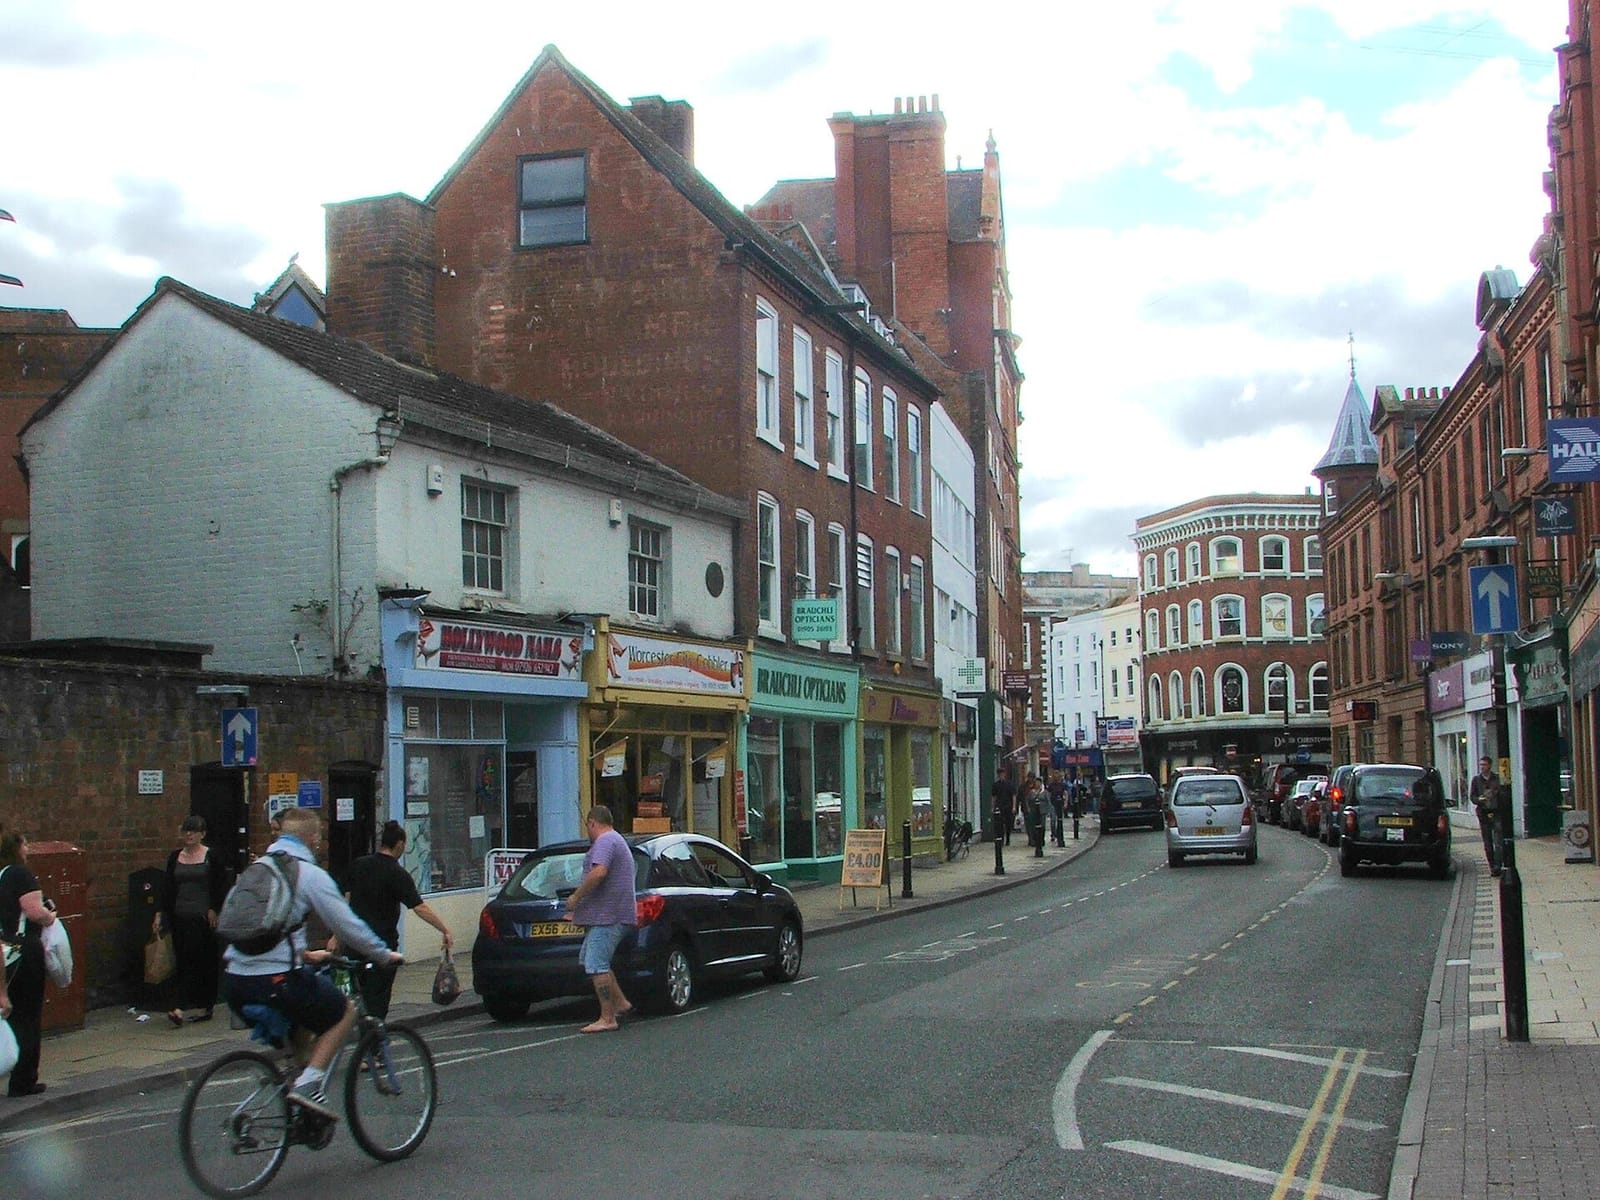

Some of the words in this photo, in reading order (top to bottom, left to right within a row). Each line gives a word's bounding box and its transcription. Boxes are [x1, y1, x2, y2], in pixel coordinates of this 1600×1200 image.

[1552, 441, 1600, 458] HAL
[795, 615, 836, 624] OPTICIANS
[440, 625, 524, 658] HOLLYWOOD
[525, 635, 563, 661] NAILS
[628, 645, 673, 663] Worcester
[697, 654, 728, 672] Cobbler
[757, 667, 802, 699] BRAUCHLE
[803, 675, 847, 705] OPTICIANS
[847, 852, 881, 868] £4.00
[531, 923, 559, 936] EX56
